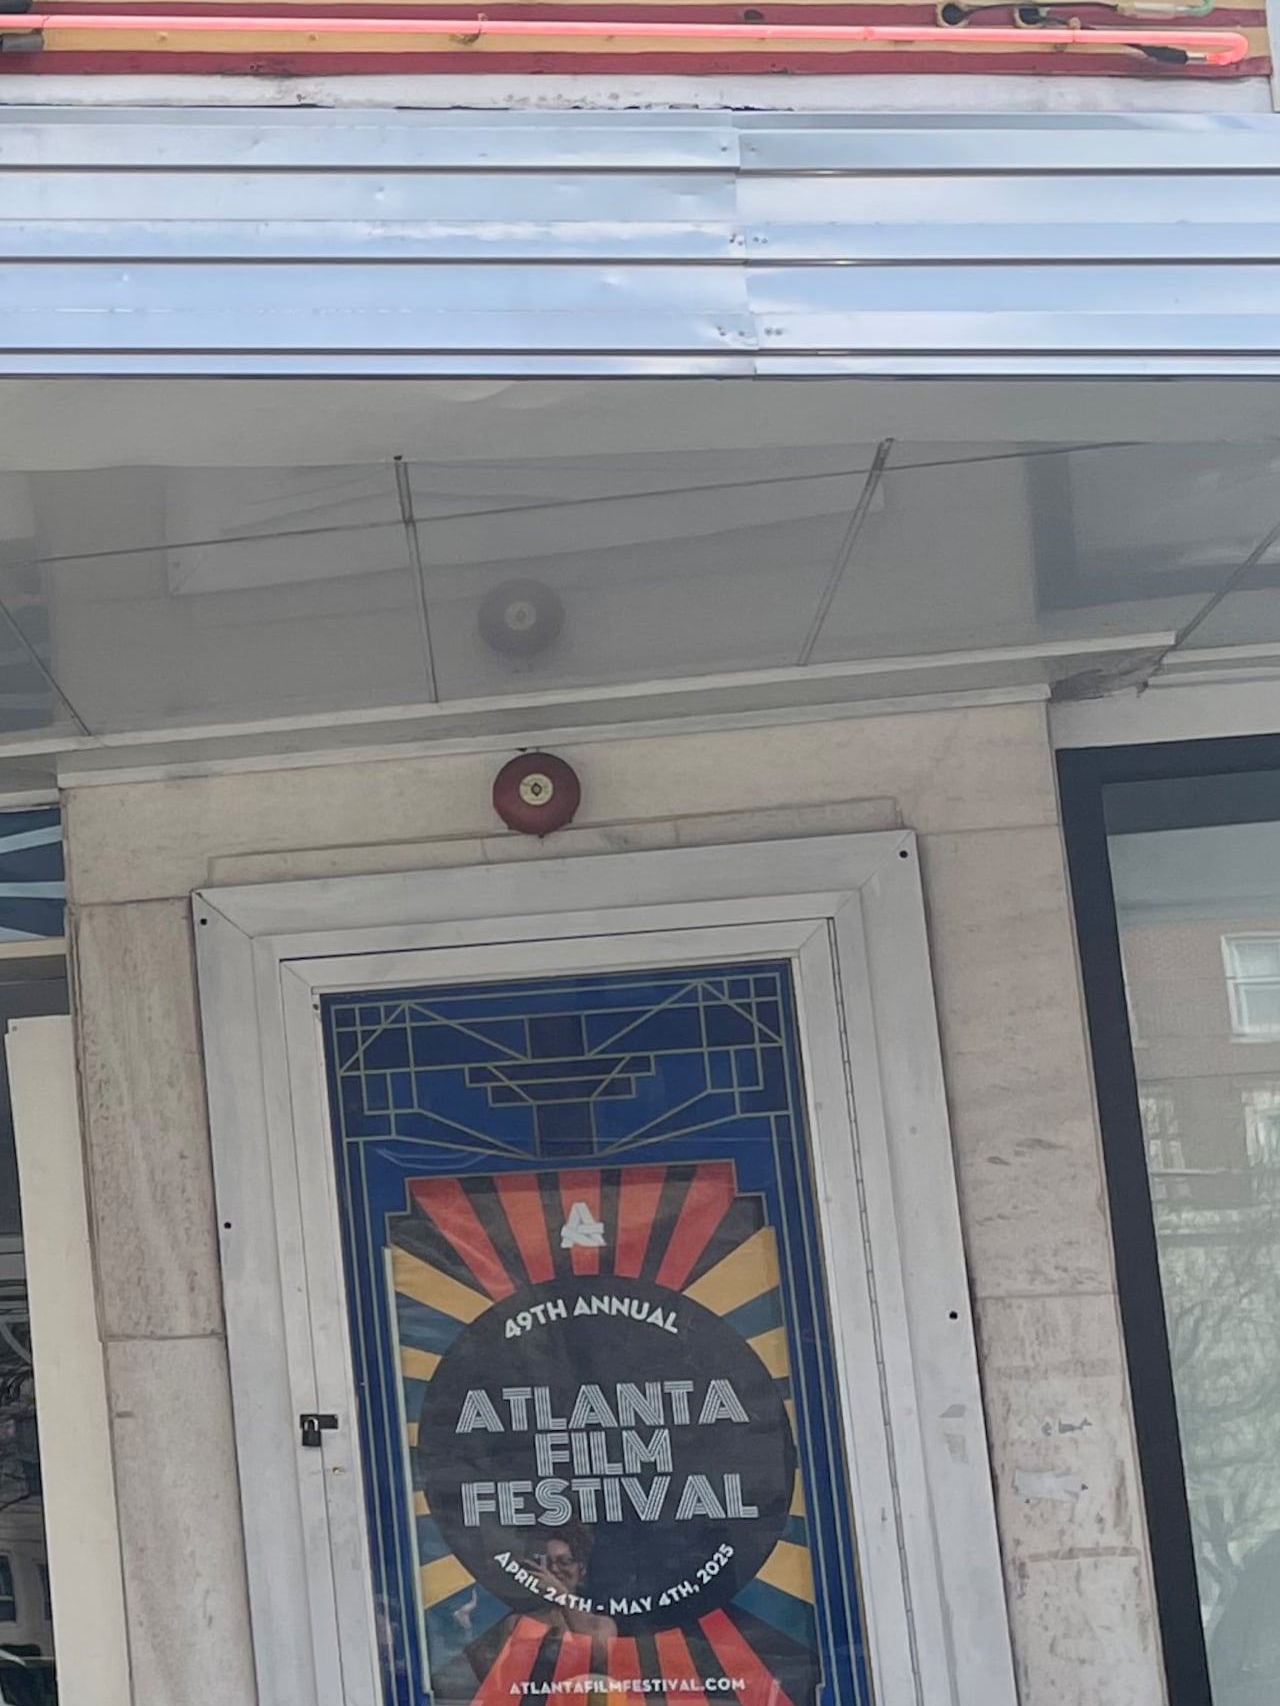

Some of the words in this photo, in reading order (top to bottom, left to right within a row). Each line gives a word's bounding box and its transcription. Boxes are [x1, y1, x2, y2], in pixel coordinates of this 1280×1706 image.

[504, 1298, 569, 1339] 49TH
[572, 1295, 679, 1334] ANNUAL
[454, 1378, 750, 1434] ATLANTA
[533, 1428, 674, 1477] FILM
[460, 1472, 760, 1527] FESTIVAL
[493, 1550, 541, 1595] APRIL
[543, 1587, 592, 1614] 24TH
[609, 1596, 653, 1616] MAY
[658, 1580, 700, 1608] 4TH,
[696, 1542, 735, 1585] 2025
[509, 1677, 746, 1696] ATLANTAFILMFESTIVAL.COM
